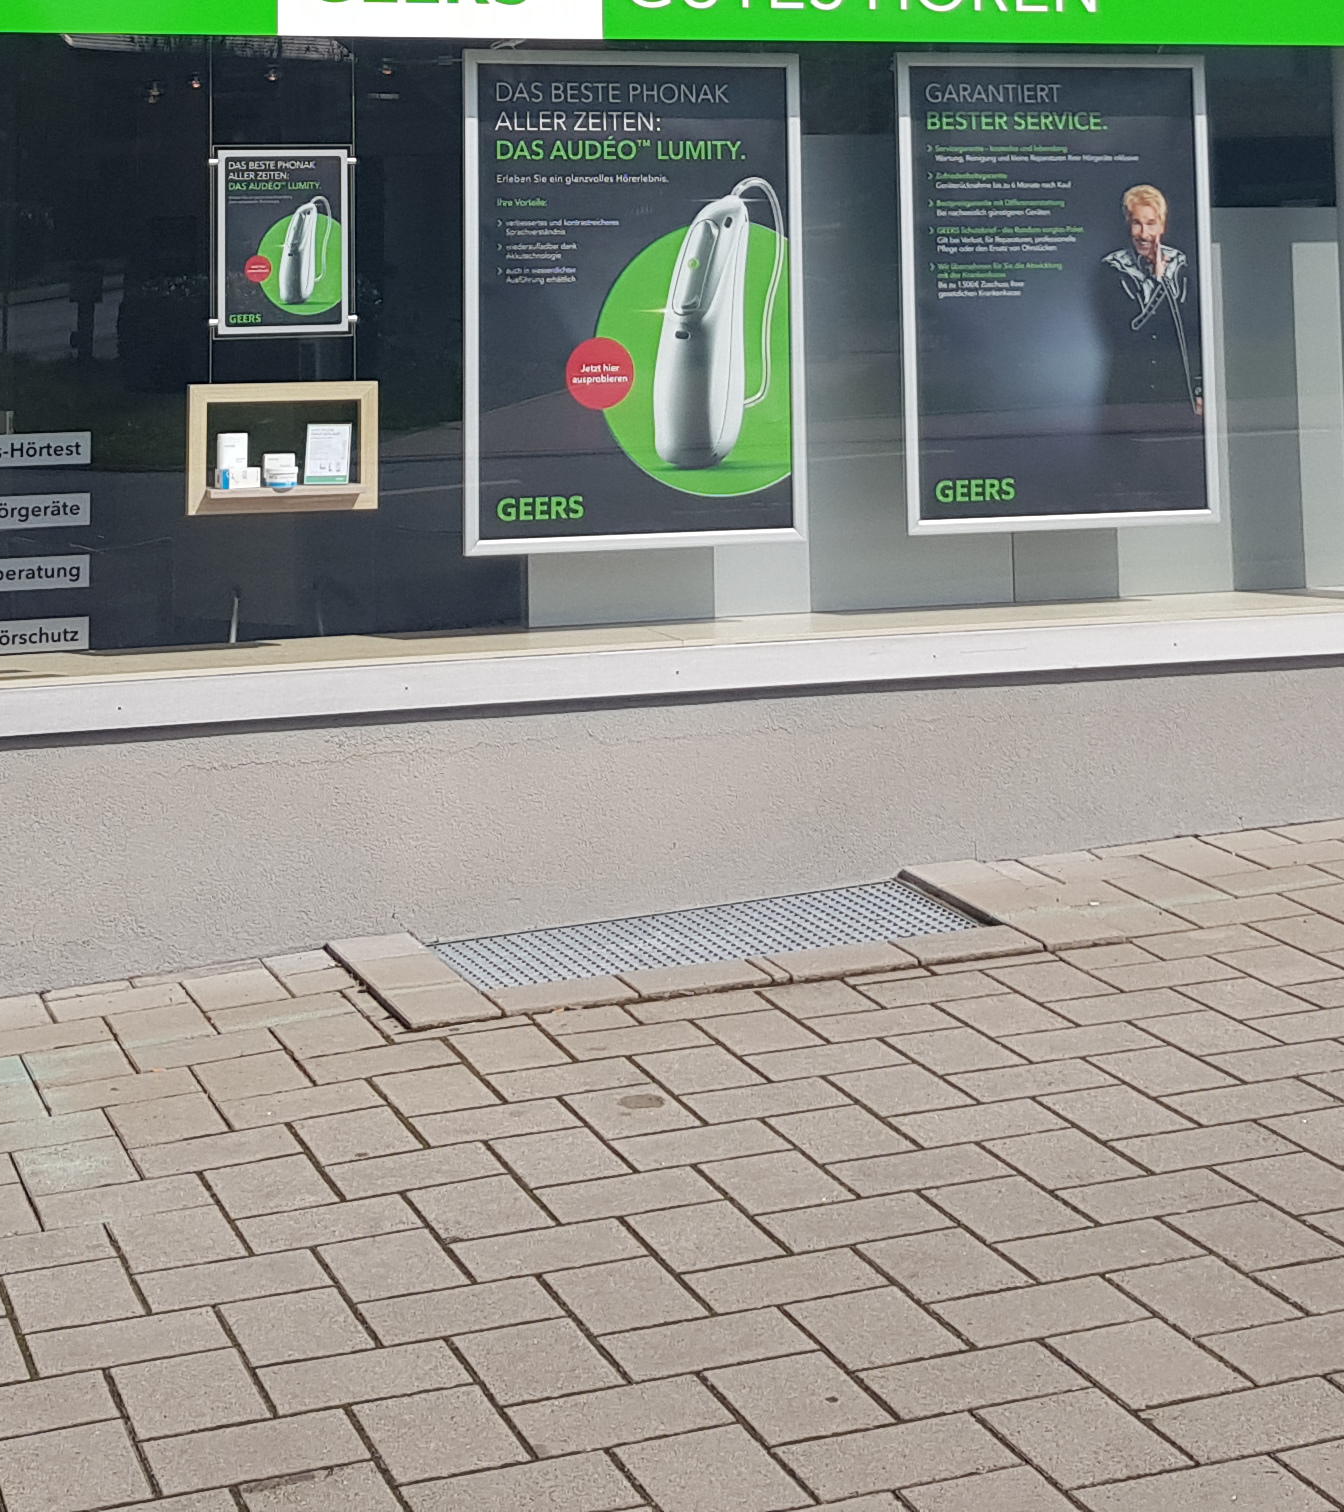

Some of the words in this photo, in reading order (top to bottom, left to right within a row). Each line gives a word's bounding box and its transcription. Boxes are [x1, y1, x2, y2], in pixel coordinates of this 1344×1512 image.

[496, 82, 543, 103] DAS
[551, 83, 622, 103] BESTE
[628, 83, 729, 104] PHONAK
[925, 83, 1062, 103] GARANTIERT
[495, 111, 567, 132] ALLER
[573, 112, 662, 132] ZEITEN:
[926, 111, 1008, 131] BESTER
[1013, 111, 1109, 131] SERVICE.
[495, 140, 544, 160] DAS
[657, 140, 747, 160] LUMITY.
[228, 161, 246, 170] DAS
[249, 161, 275, 170] BESTE
[277, 160, 316, 169] PHONAK
[228, 171, 255, 180] ALLER
[228, 181, 246, 190] DAS
[496, 173, 531, 183] Erleben
[534, 173, 547, 183] Sie
[549, 173, 563, 183] ein
[565, 173, 614, 185] glanzvolles
[229, 314, 262, 324] GEERS
[580, 364, 602, 374] Jetzt
[603, 363, 620, 373] hier
[935, 477, 1016, 504] GEERS
[496, 495, 586, 522] GEERS
